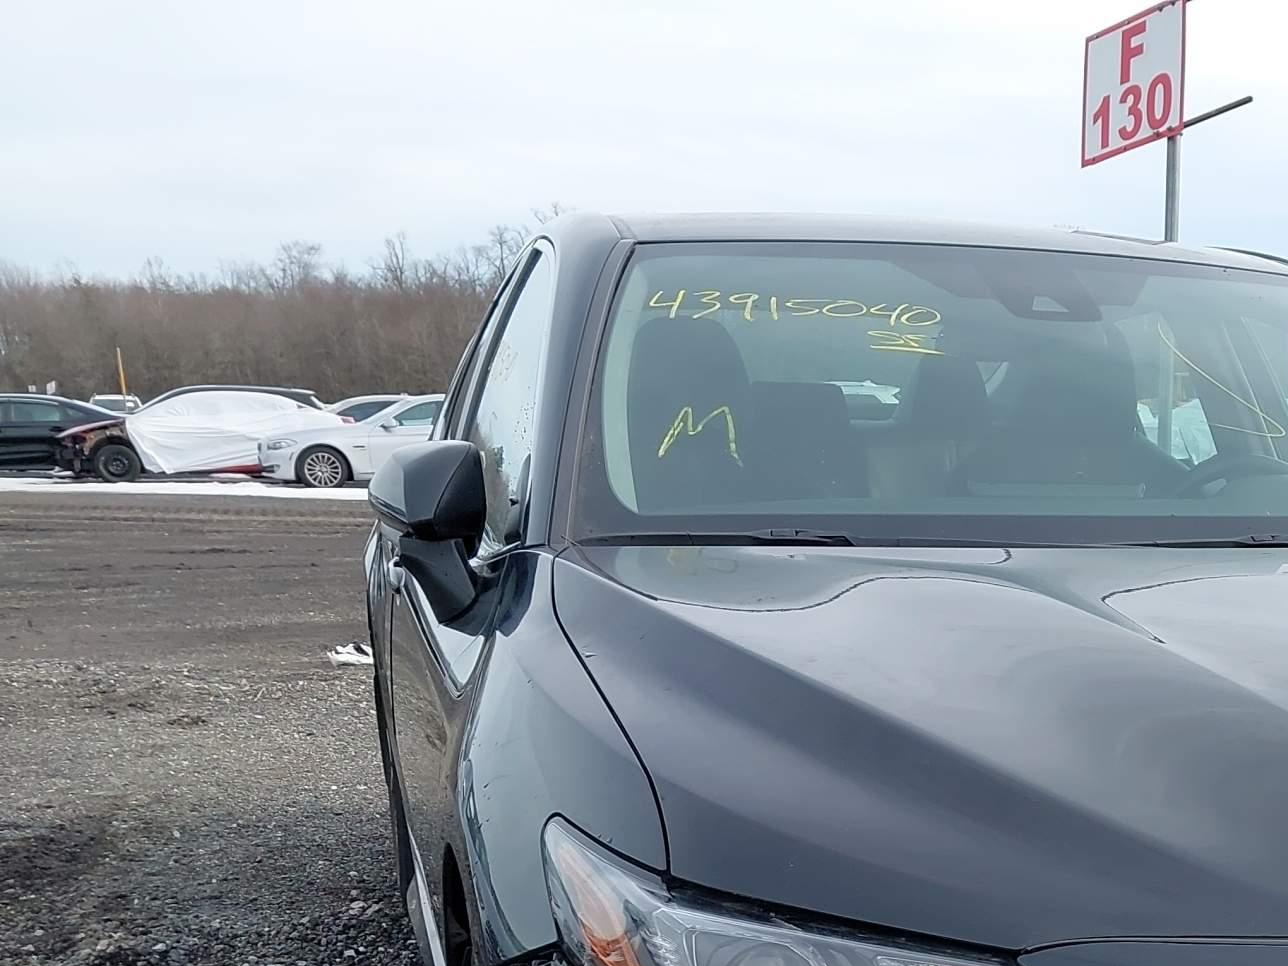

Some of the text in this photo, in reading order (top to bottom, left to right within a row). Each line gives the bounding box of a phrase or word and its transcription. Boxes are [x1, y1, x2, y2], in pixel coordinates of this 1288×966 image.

[1119, 20, 1147, 86] F
[1092, 72, 1173, 150] 130
[649, 289, 942, 327] 43915040
